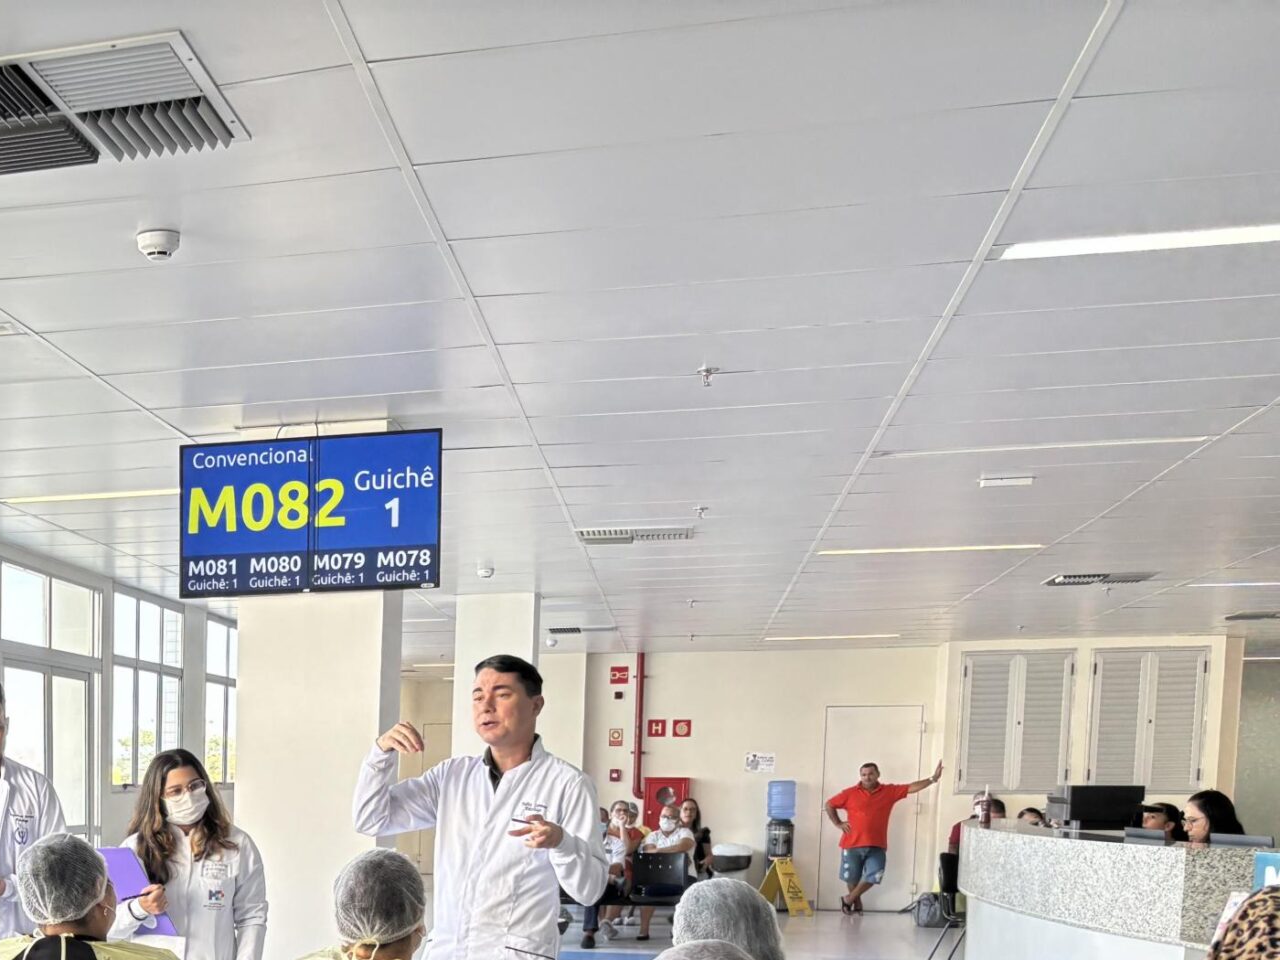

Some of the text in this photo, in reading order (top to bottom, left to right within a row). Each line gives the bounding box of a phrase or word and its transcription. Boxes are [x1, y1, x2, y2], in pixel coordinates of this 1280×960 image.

[192, 443, 313, 469] Convencional
[354, 465, 434, 491] Guichê
[187, 478, 346, 534] M082
[384, 497, 400, 528] 1
[188, 549, 431, 577] M081 M080 M079 M078
[187, 578, 238, 591] Guichê: 1
[249, 575, 300, 588] Guichê: 1
[312, 572, 364, 585] Guichê: 1
[376, 569, 429, 583] Guichê: 1
[651, 722, 662, 735] H
